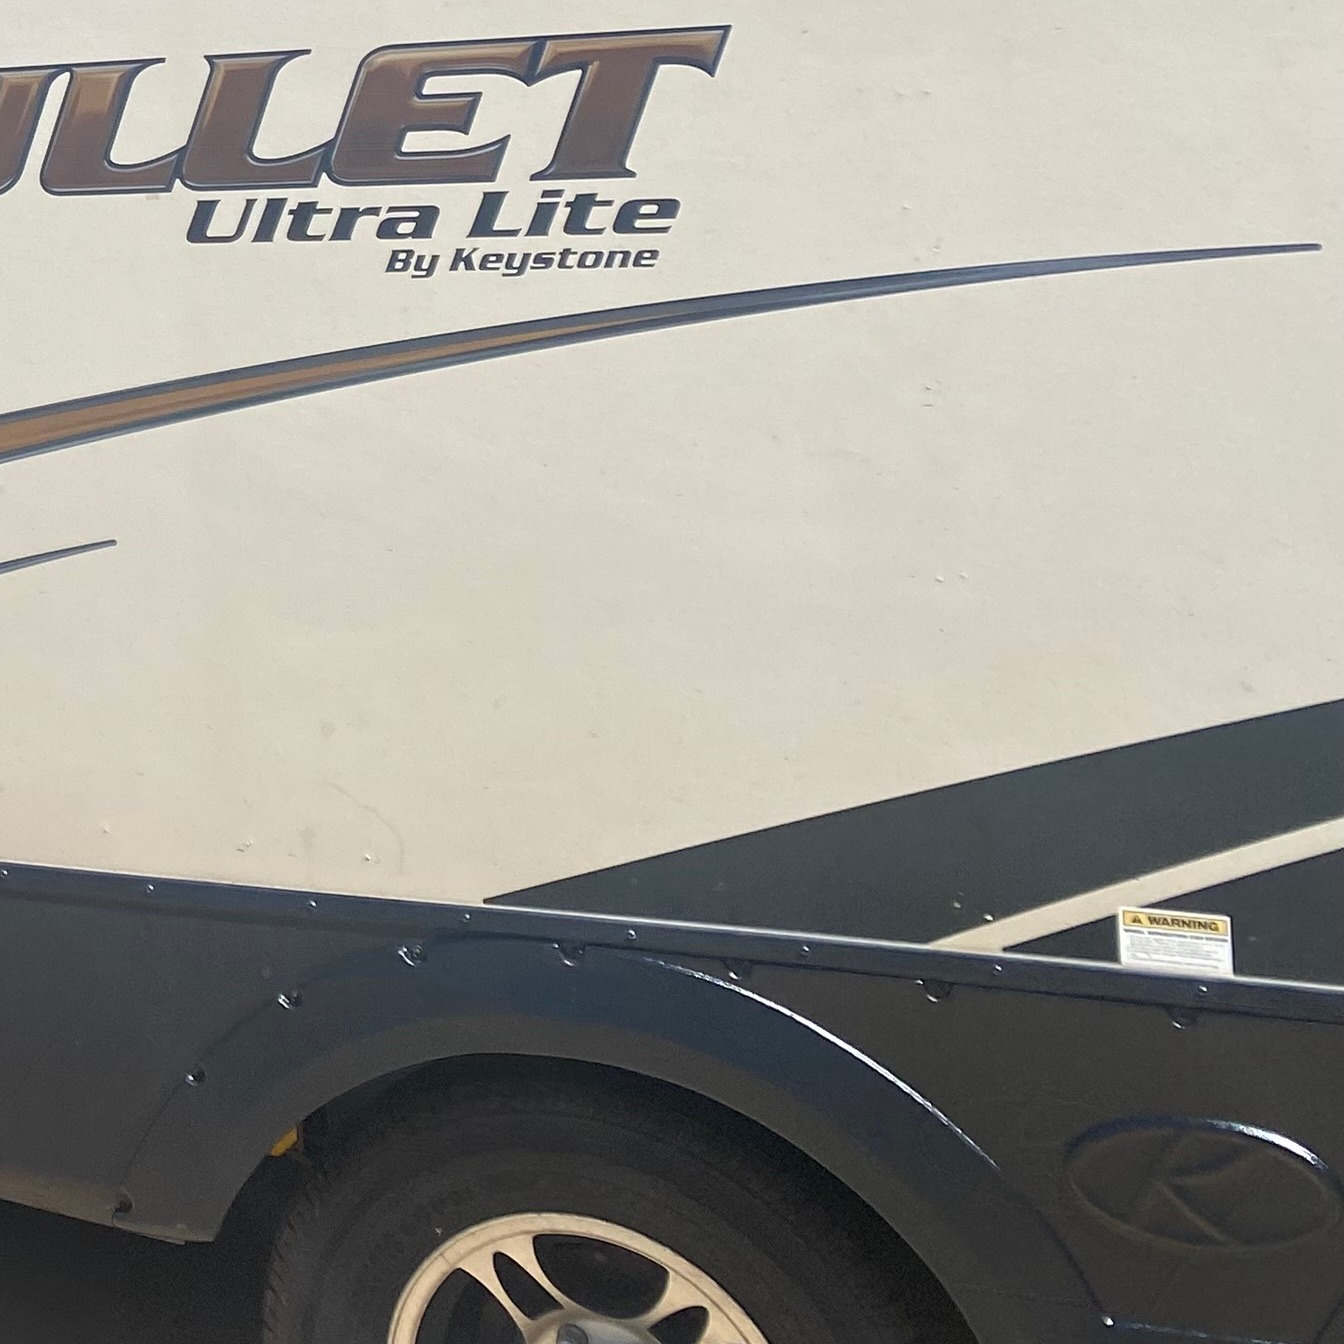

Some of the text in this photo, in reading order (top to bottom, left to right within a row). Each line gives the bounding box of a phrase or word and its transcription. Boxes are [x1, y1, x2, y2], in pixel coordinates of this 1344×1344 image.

[186, 187, 681, 244] Ultra Lite
[384, 246, 660, 279] By Keystone
[1147, 916, 1220, 933] WARNING
